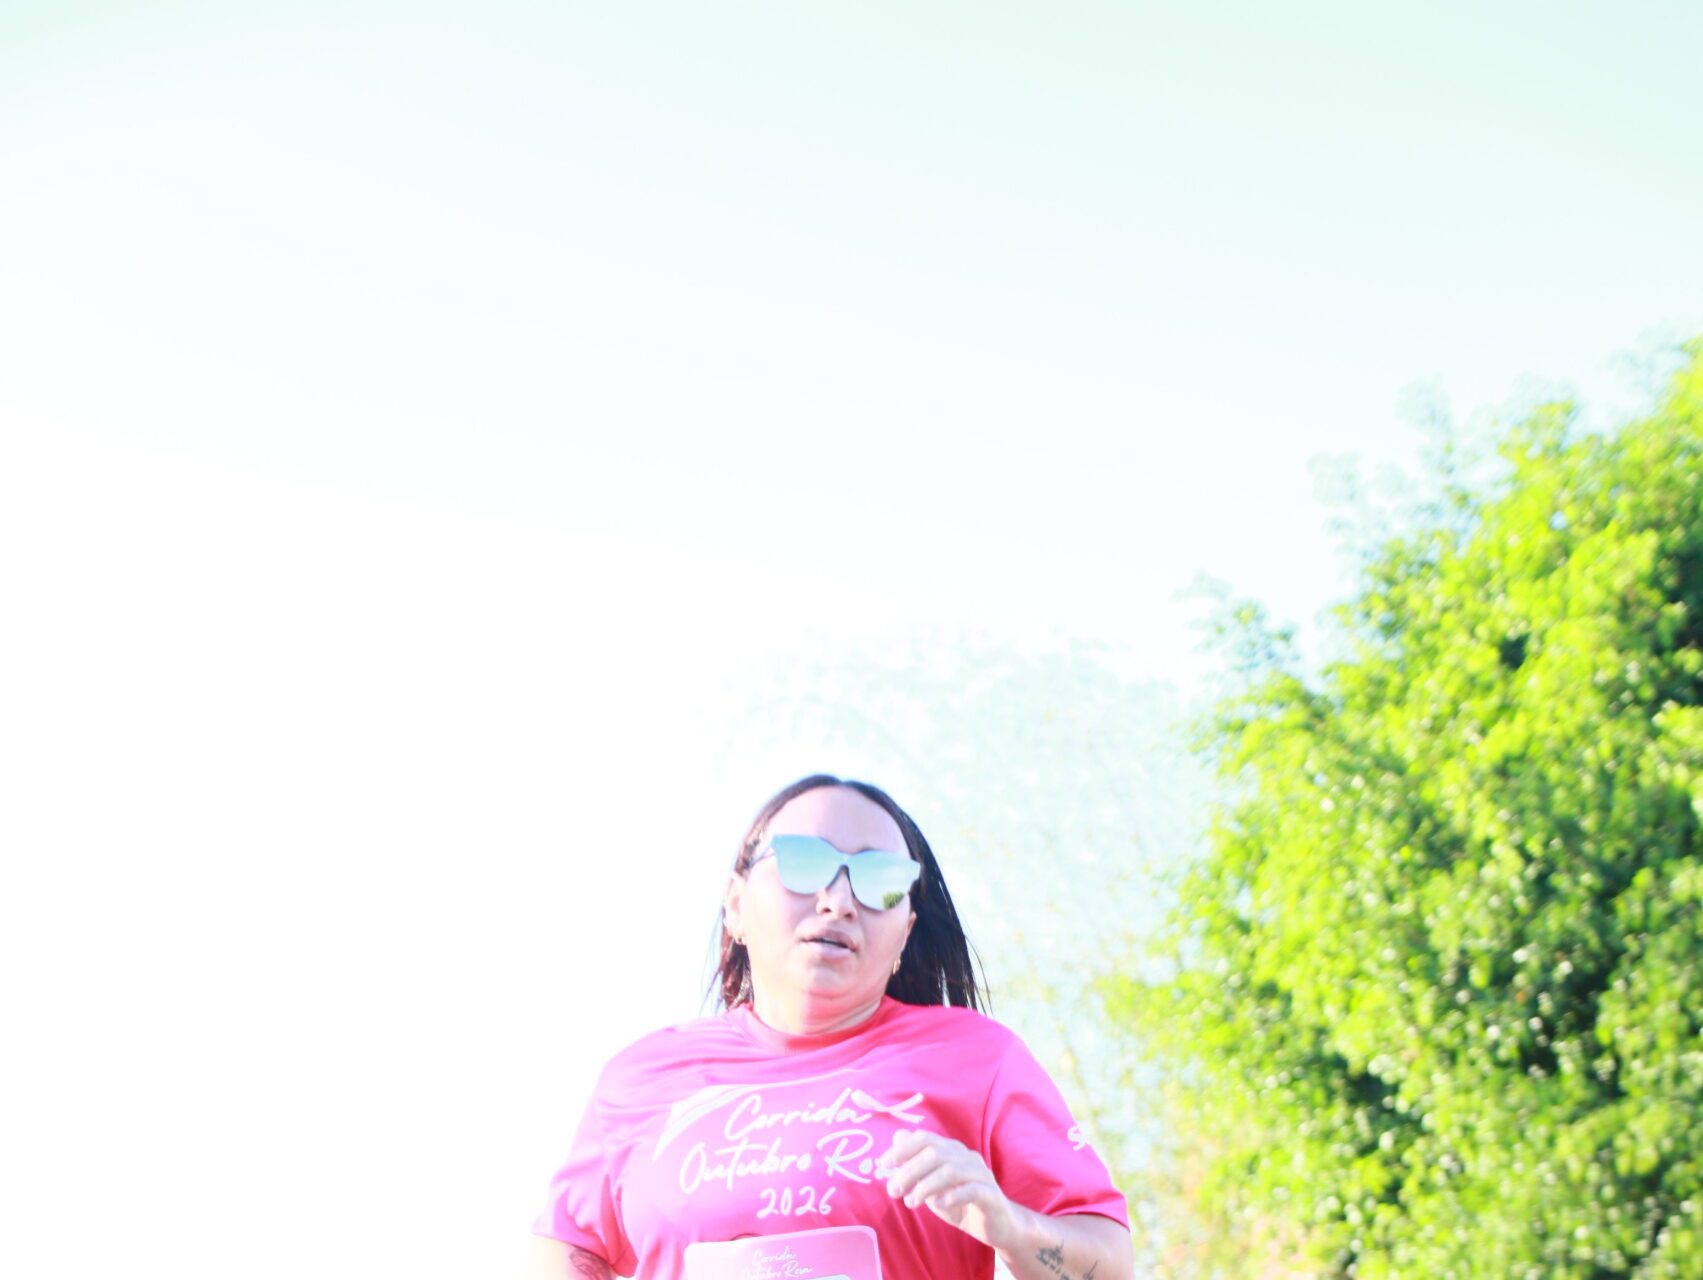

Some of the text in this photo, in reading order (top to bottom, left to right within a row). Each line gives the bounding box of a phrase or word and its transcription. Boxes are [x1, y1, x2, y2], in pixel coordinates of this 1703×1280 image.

[724, 1088, 872, 1140] Corrida
[680, 1137, 811, 1193] Outubro
[756, 1186, 836, 1218] 2026
